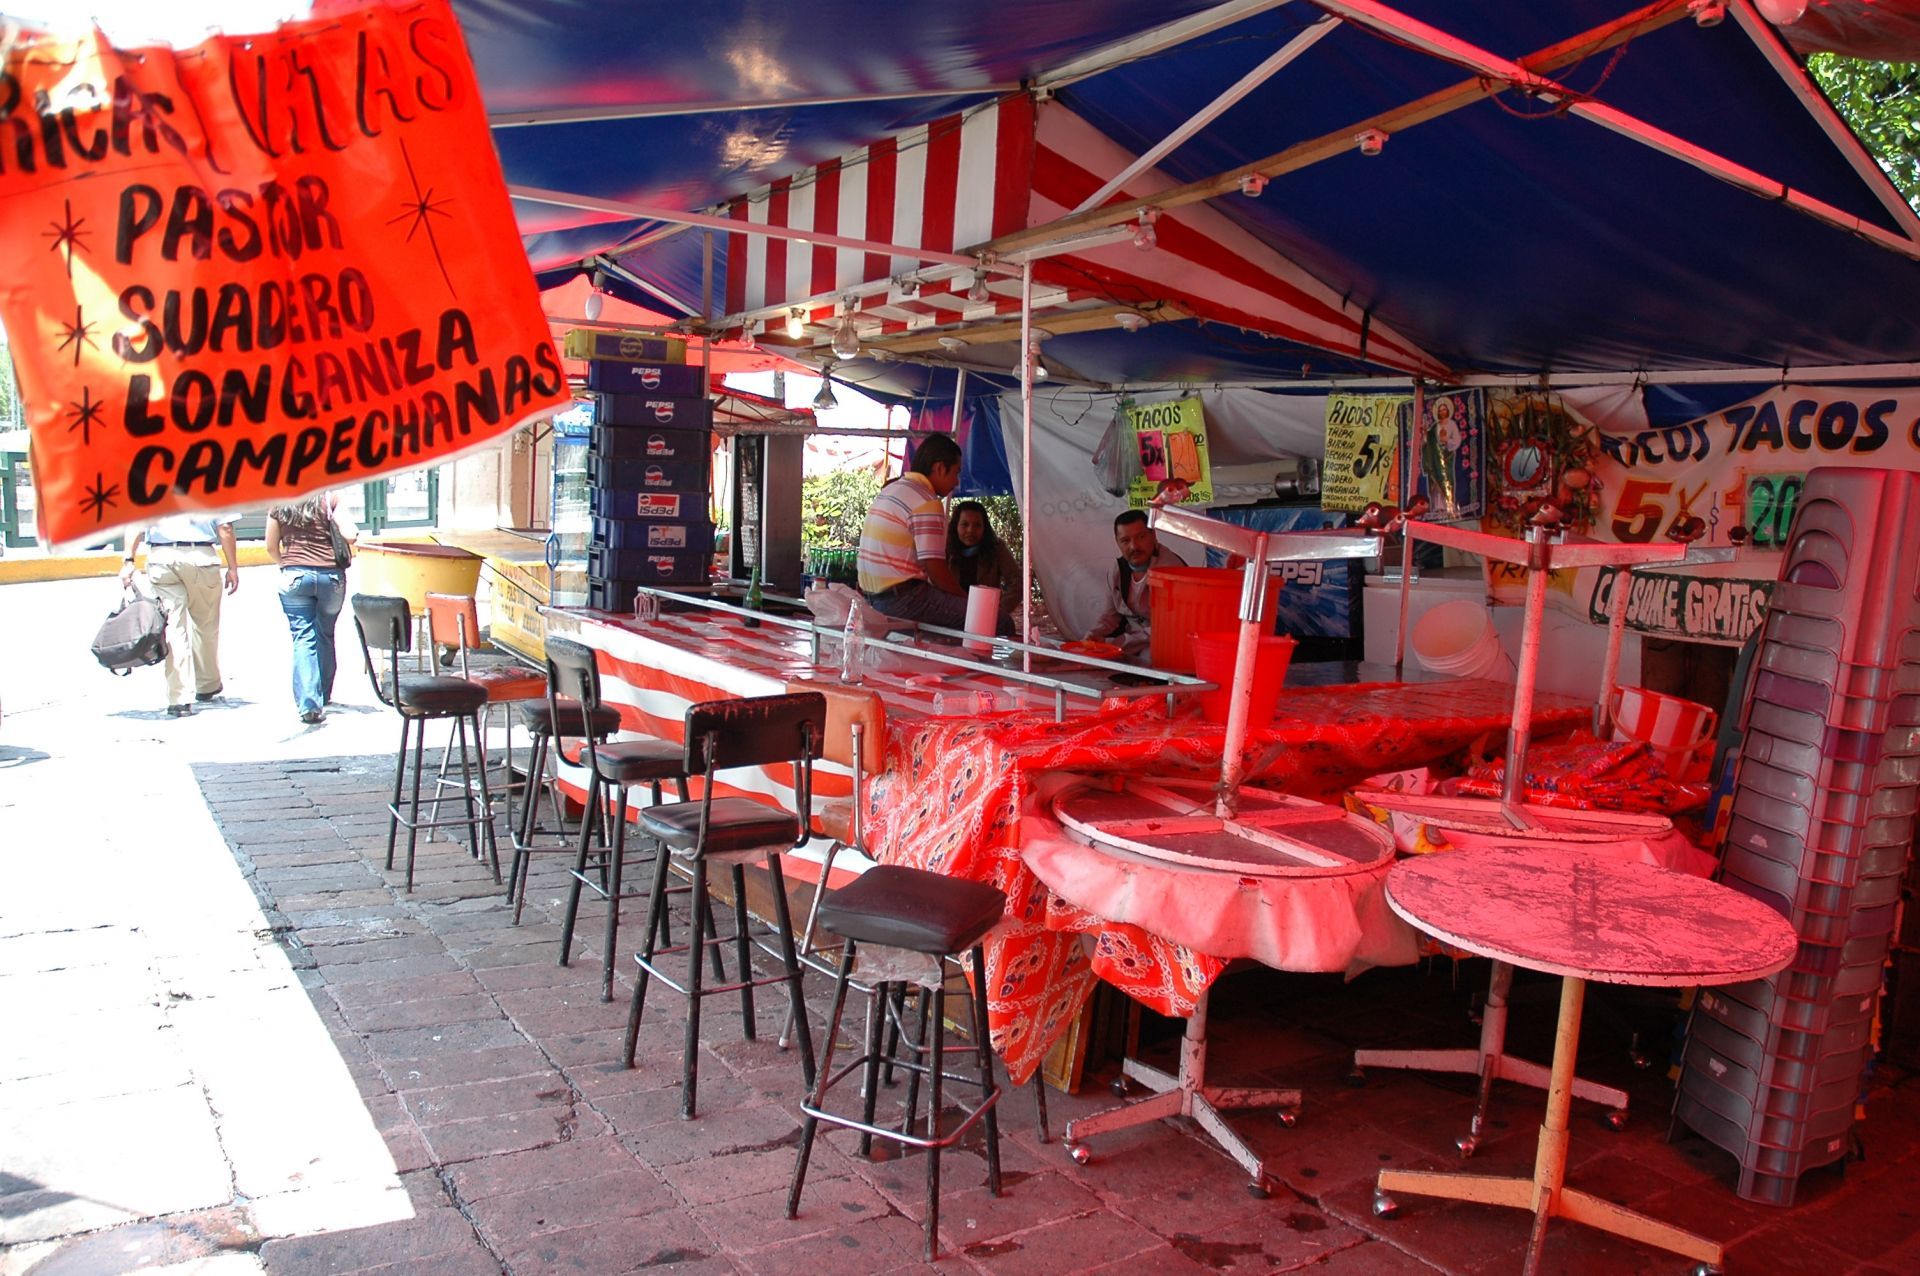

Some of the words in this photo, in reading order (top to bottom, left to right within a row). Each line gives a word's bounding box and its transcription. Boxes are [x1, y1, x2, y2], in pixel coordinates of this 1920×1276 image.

[115, 176, 343, 266] PASTOR
[114, 267, 375, 364] SUADERO
[123, 308, 478, 438] LONGANIZA
[631, 367, 662, 375] PEPSI
[645, 401, 675, 409] PEPSI
[1135, 405, 1182, 430] TACOS
[1328, 400, 1373, 427] RICOS
[127, 341, 563, 507] CAMPECHANAS
[1717, 399, 1898, 453] TACOS
[1328, 428, 1355, 440] TRIPA
[1327, 439, 1357, 450] BIRRIA
[647, 448, 675, 456] PEPSI
[1325, 461, 1352, 474] PASTOR
[644, 479, 673, 487] PEPSI
[639, 505, 675, 516] PEPSI
[650, 538, 682, 547] PEPSI
[647, 555, 675, 563] PEPSI
[1268, 561, 1324, 585] EPSI
